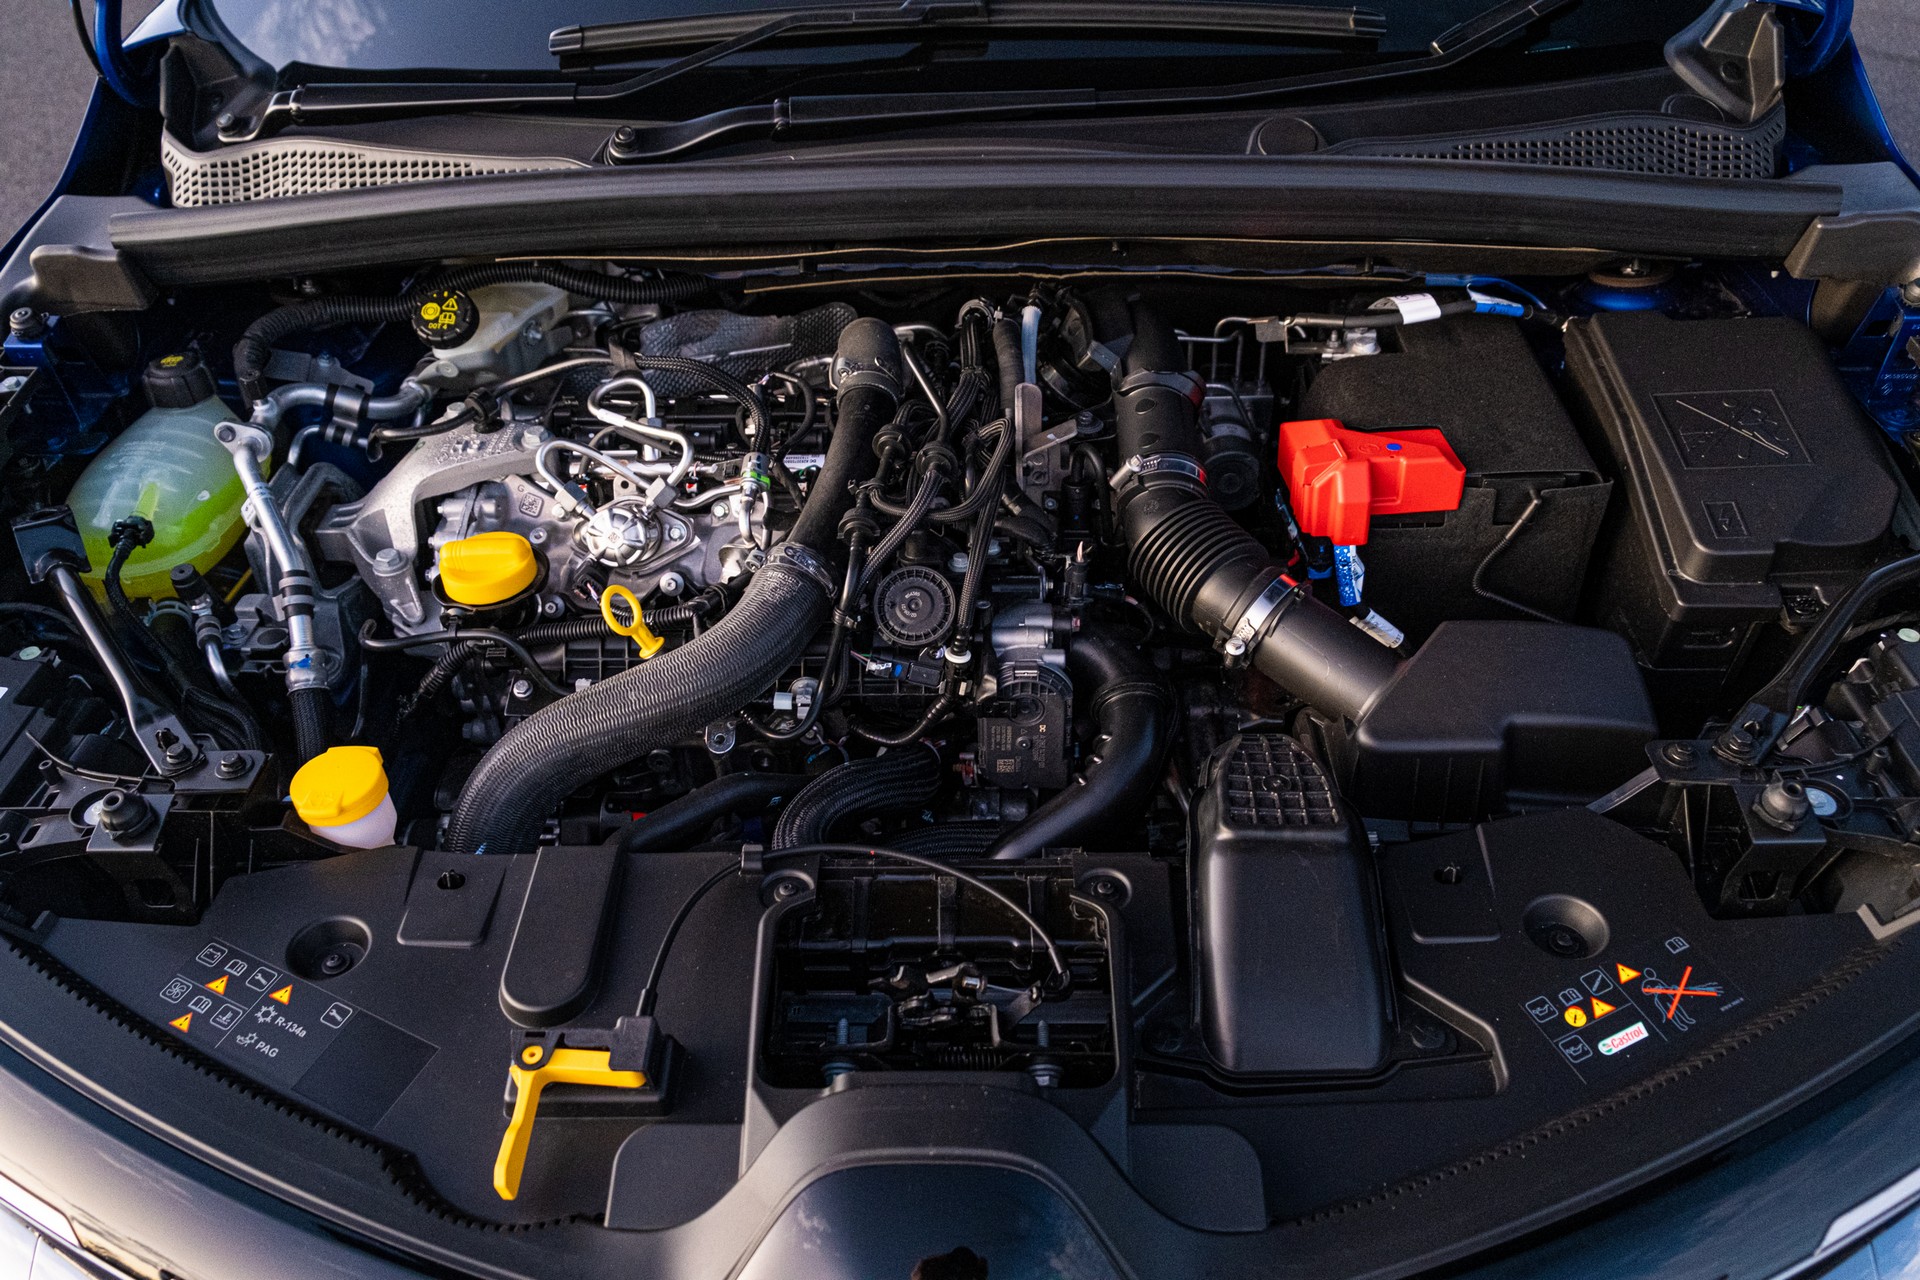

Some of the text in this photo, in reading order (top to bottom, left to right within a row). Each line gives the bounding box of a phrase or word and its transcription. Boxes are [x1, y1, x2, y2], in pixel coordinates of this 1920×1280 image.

[275, 1016, 307, 1038] R-134a
[1611, 1026, 1644, 1048] Castrol
[255, 1041, 279, 1058] PAG
